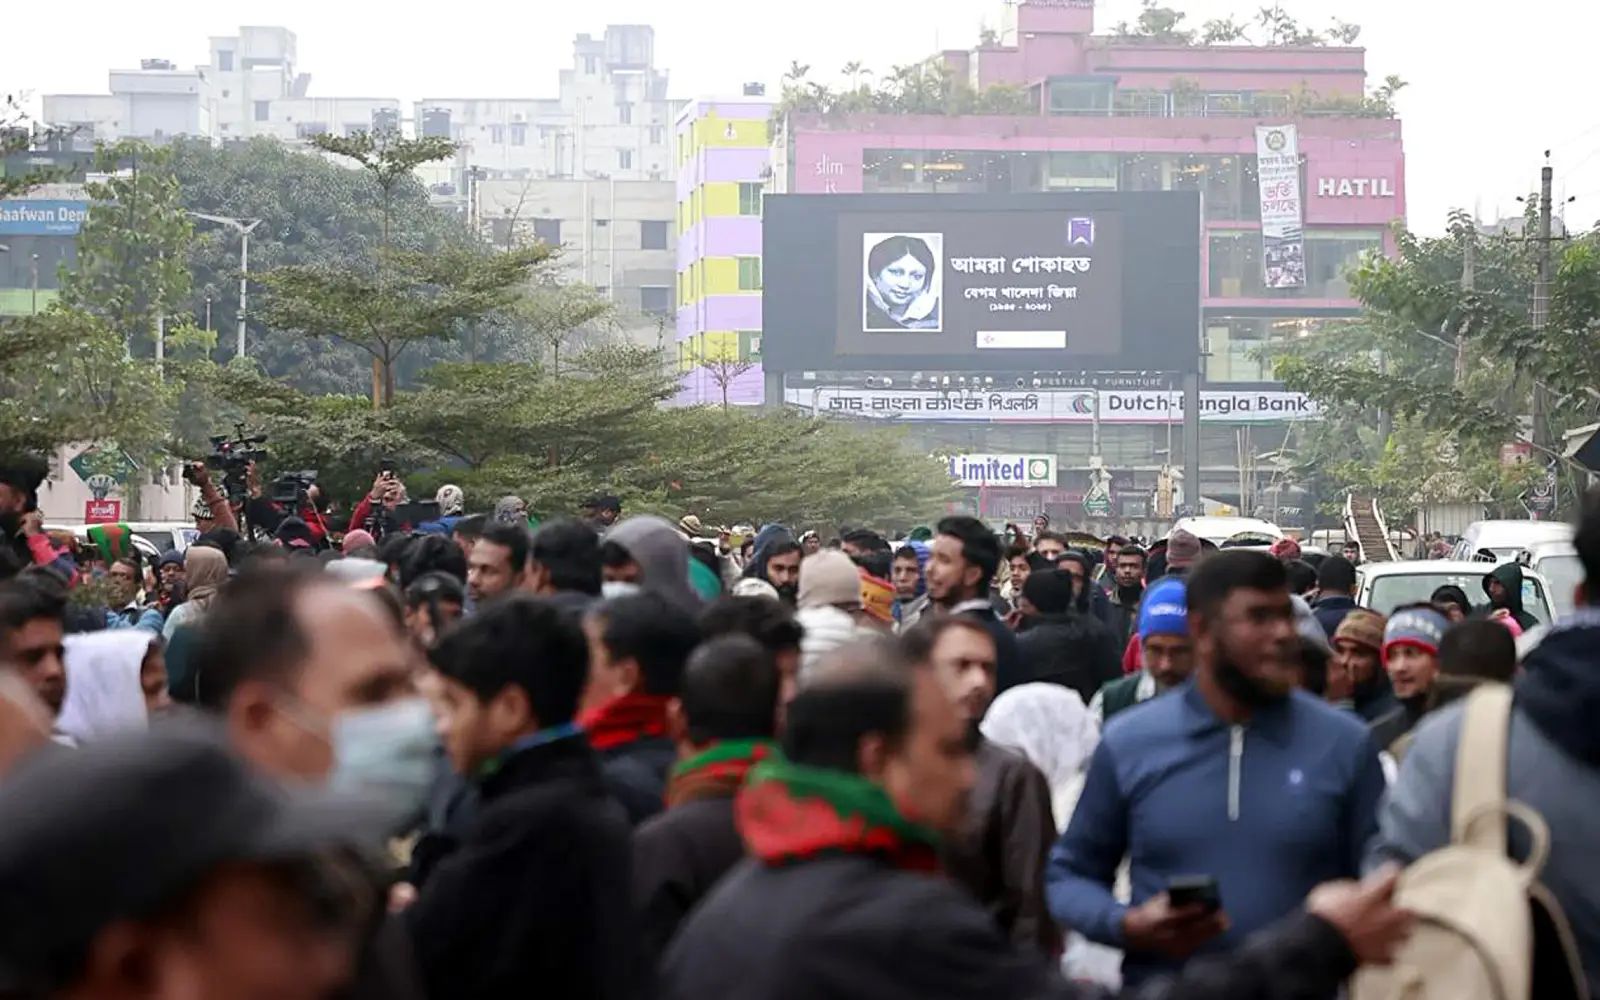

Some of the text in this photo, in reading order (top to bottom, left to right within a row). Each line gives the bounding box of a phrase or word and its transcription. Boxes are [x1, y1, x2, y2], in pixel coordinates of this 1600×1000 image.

[815, 153, 843, 175] slim
[1318, 178, 1395, 196] HATIL
[59, 207, 85, 222] Den
[951, 257, 1091, 273] আমরা শোকাহত
[964, 284, 1077, 299] বেগম খালেদা জিয়া
[1041, 377, 1086, 386] FESTYLE
[1105, 377, 1162, 386] FURNITURE
[989, 393, 1038, 411] পিএলসি
[1109, 394, 1250, 415] Dutch-ngla
[1257, 395, 1309, 412] Bank
[951, 457, 1024, 481] Limited
